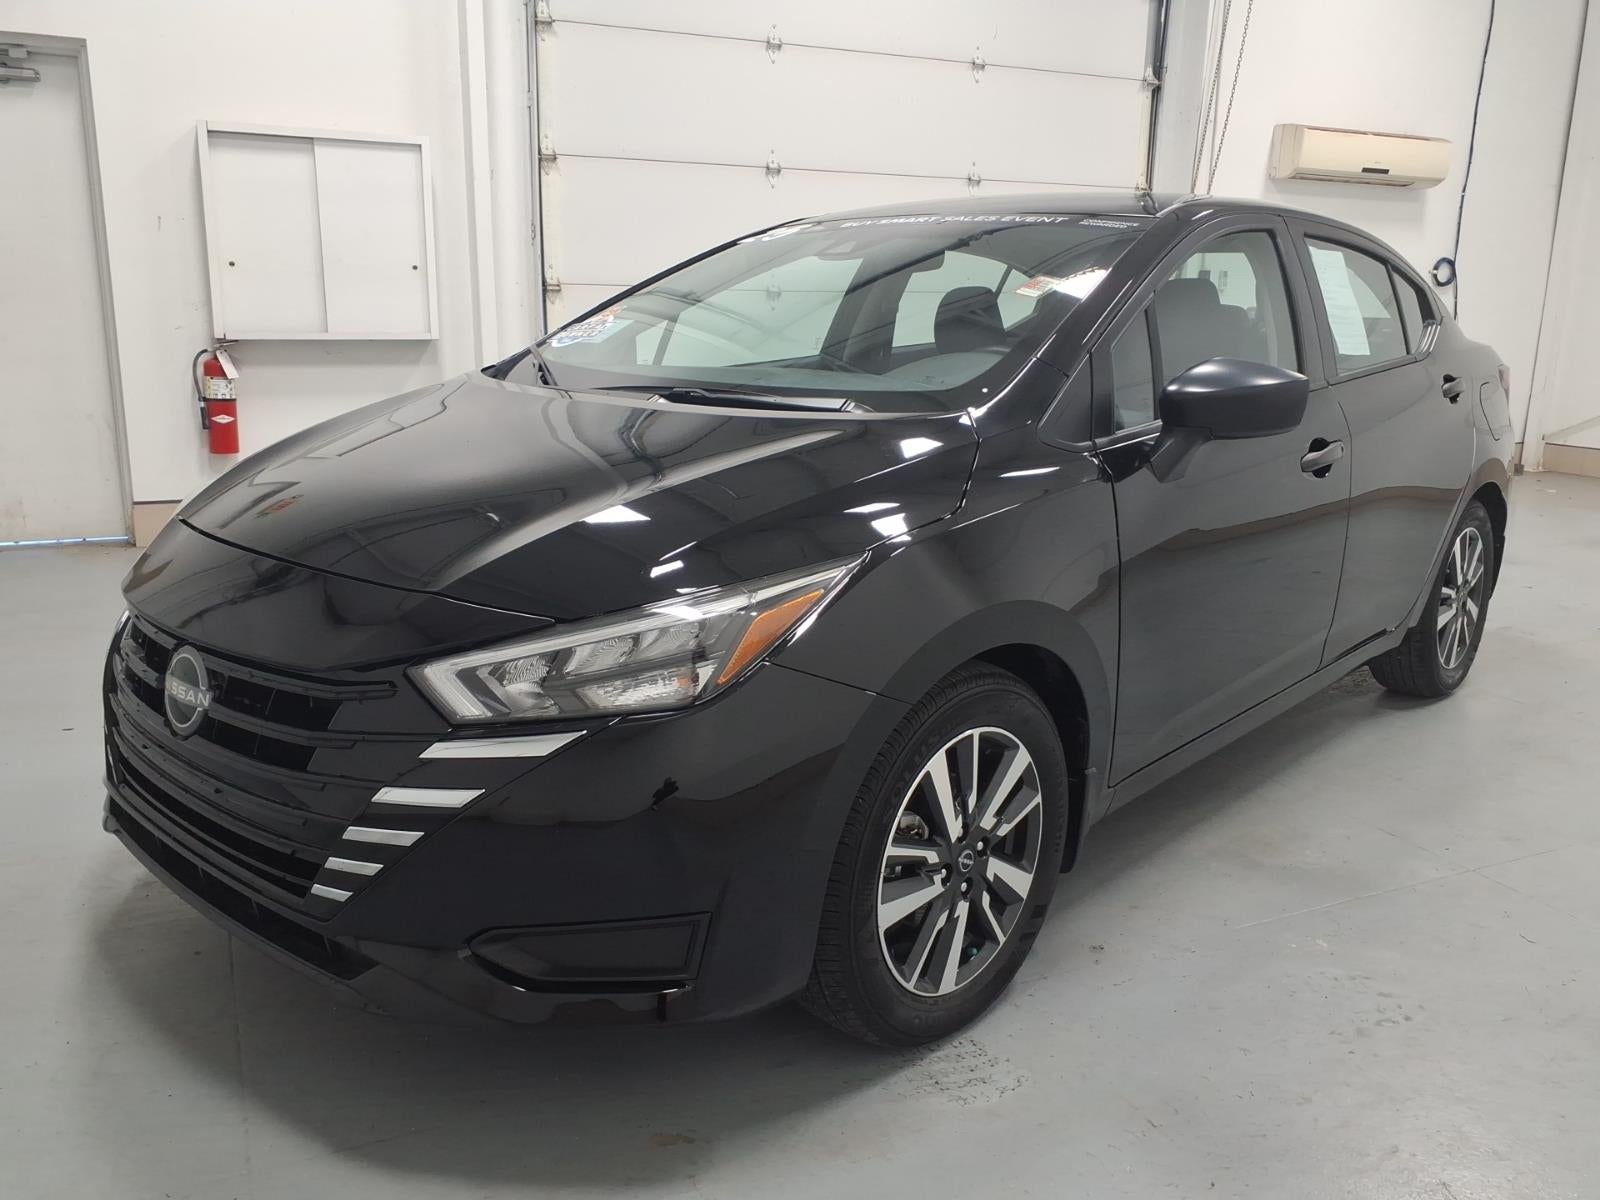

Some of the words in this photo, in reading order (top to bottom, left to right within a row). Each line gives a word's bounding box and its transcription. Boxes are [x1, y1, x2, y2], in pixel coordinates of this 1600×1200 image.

[877, 216, 940, 225] SMART
[941, 215, 1000, 223] SALES
[1001, 215, 1069, 223] EVENT
